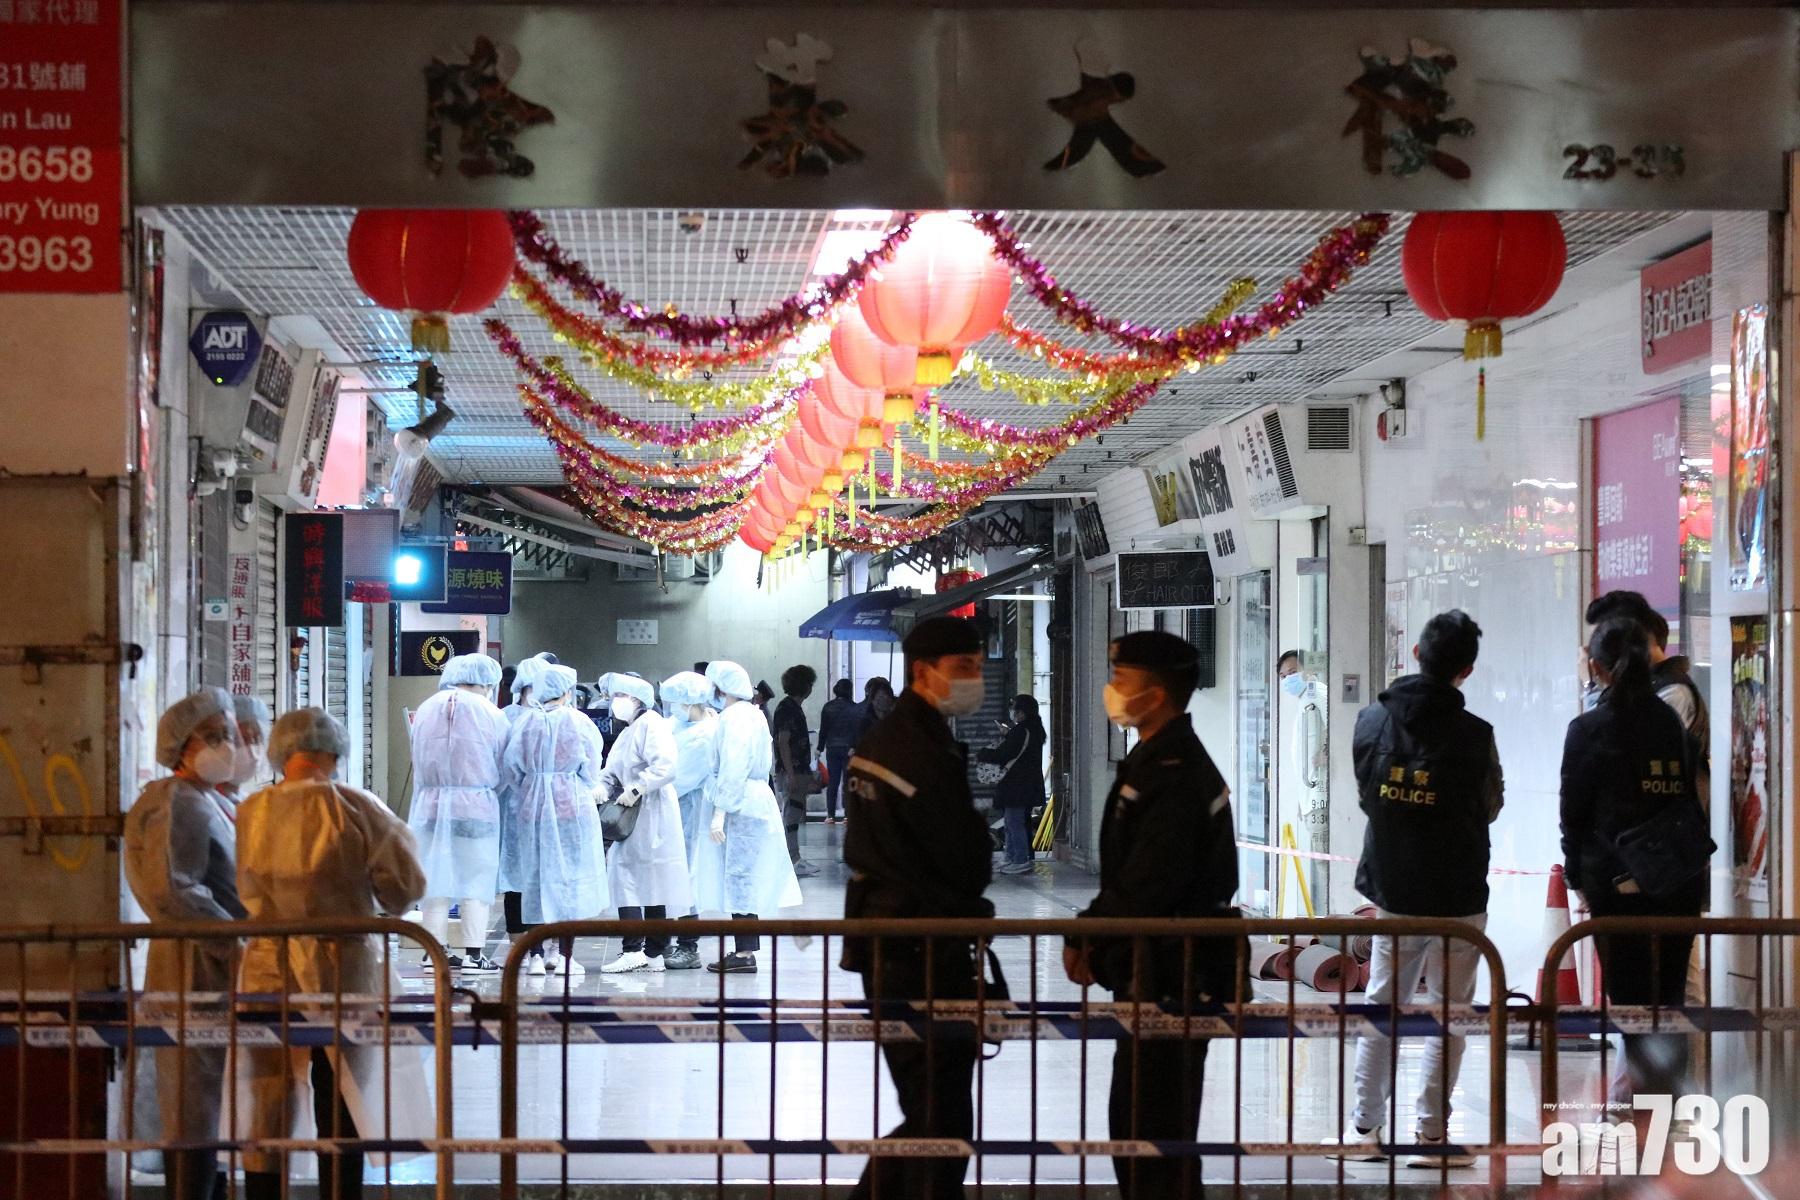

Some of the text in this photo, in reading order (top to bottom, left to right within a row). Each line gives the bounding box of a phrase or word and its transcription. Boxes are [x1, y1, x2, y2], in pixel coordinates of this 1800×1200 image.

[25, 107, 71, 130] Lau
[35, 197, 99, 226] Yung
[0, 236, 93, 272] 3963
[204, 326, 247, 349] ADT
[1379, 784, 1436, 805] POLICE
[815, 1025, 852, 1034] PLICE
